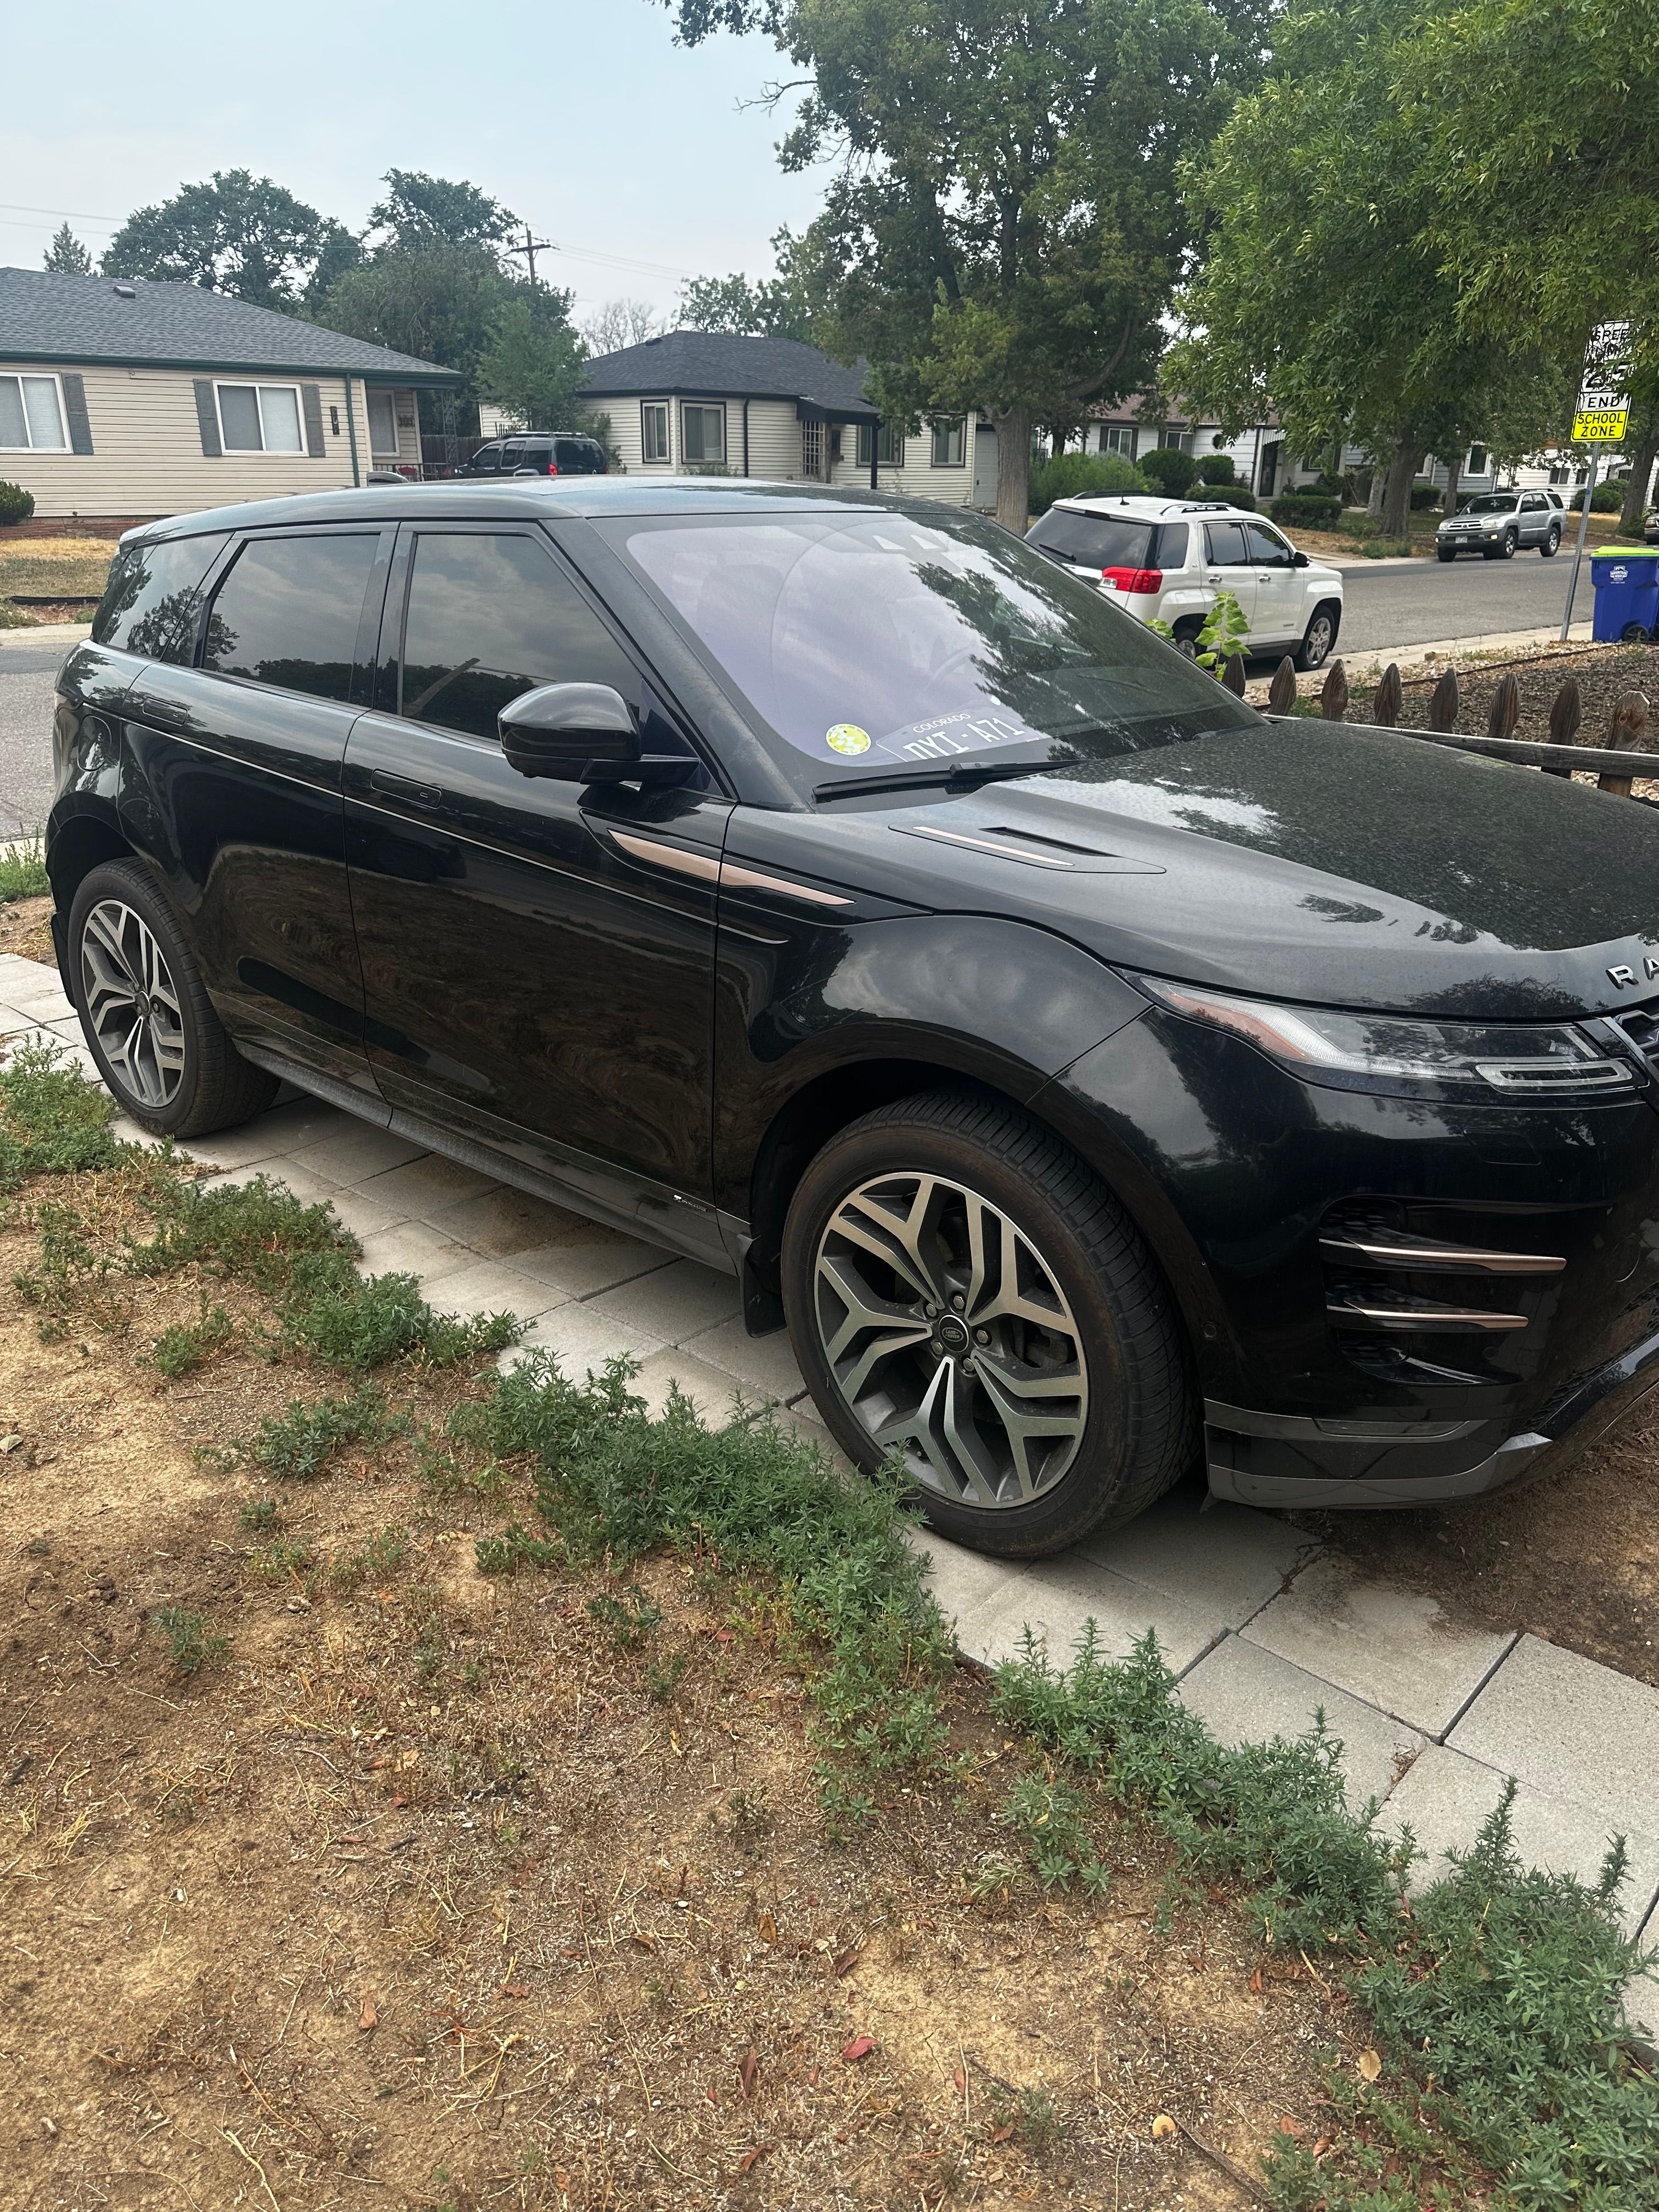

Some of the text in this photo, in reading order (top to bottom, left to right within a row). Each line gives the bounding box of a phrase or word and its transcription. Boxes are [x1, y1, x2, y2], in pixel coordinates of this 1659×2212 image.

[1592, 329, 1632, 341] SPEE
[1588, 397, 1620, 408] END
[1577, 413, 1623, 424] SCHOOL
[1581, 425, 1616, 437] ZONE
[912, 713, 970, 733] COLORADO
